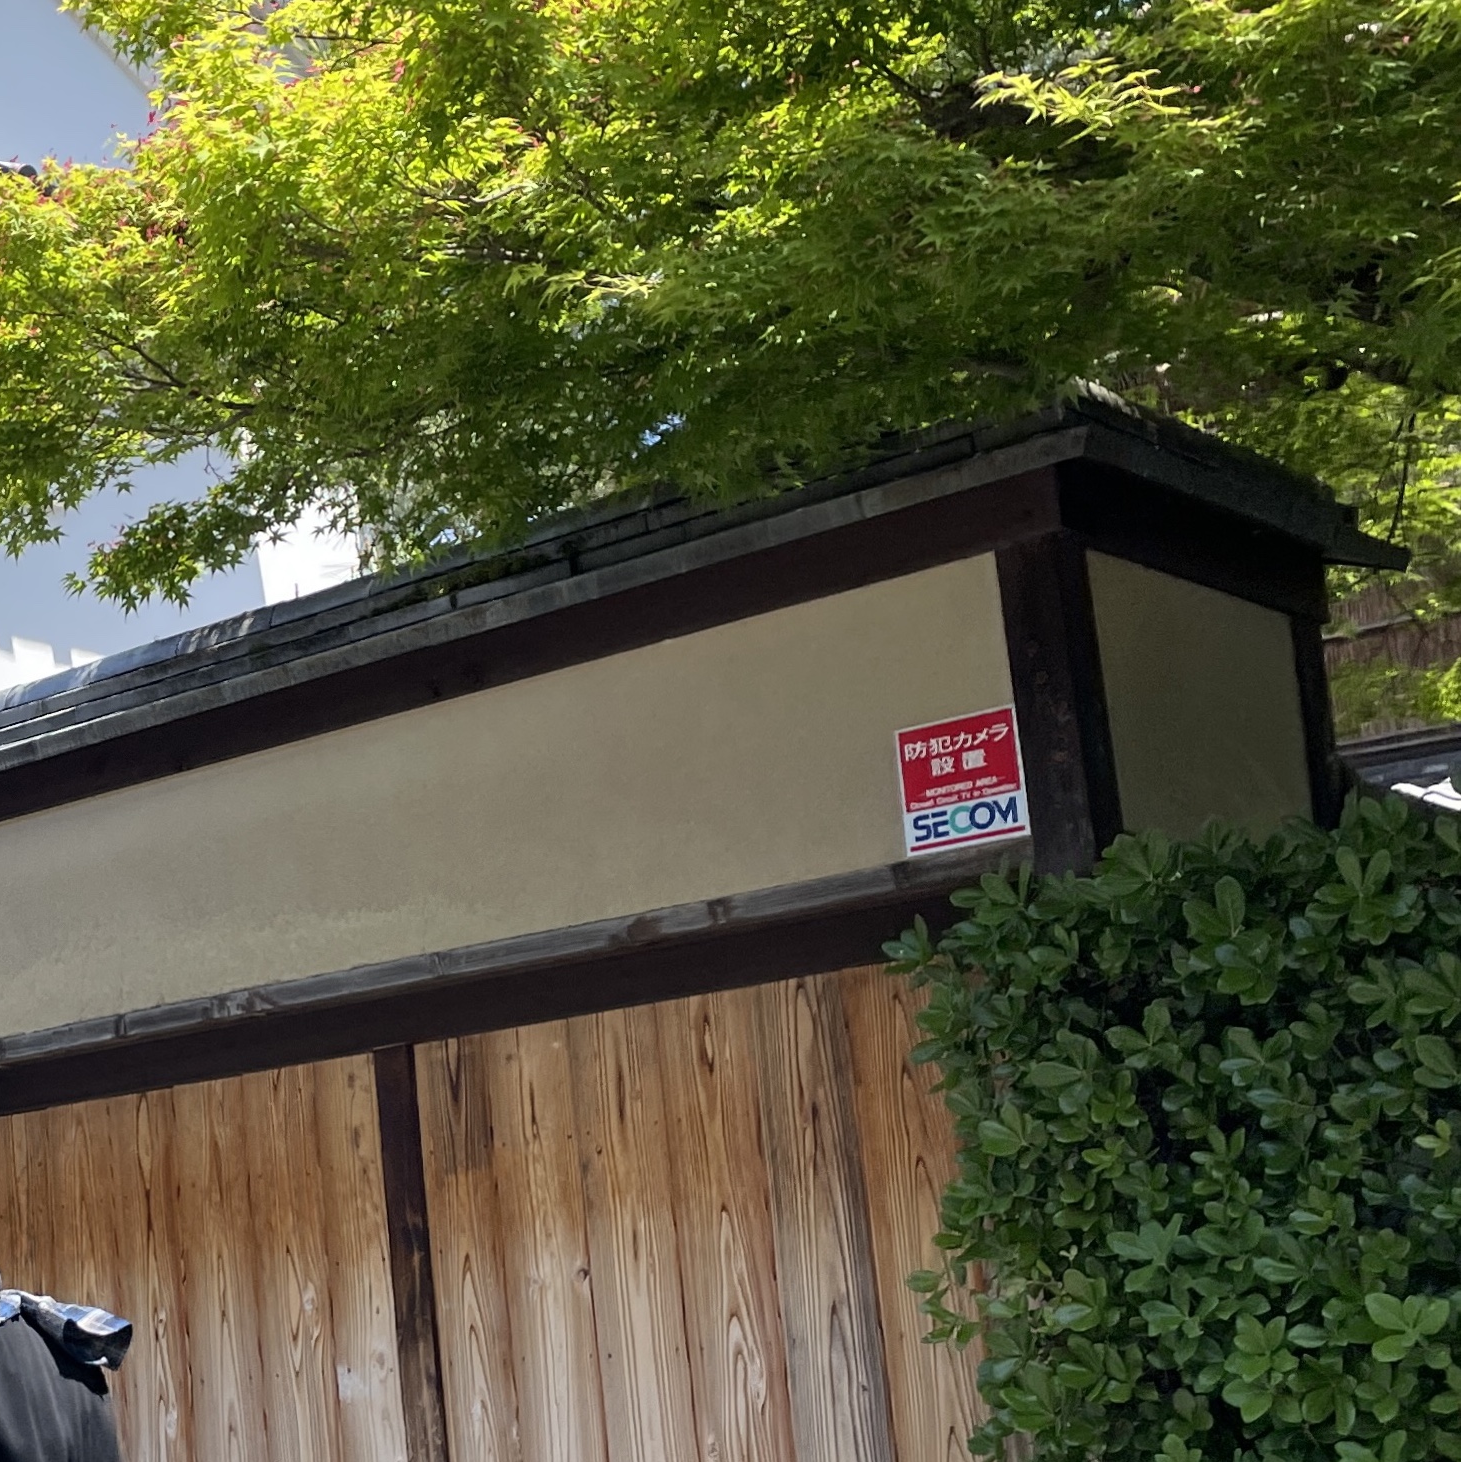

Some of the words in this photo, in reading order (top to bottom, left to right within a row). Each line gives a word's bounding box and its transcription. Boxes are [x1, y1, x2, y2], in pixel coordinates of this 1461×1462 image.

[904, 722, 1009, 762] 防犯カメラ
[930, 748, 988, 777] 設置
[913, 796, 1018, 842] SECOM
